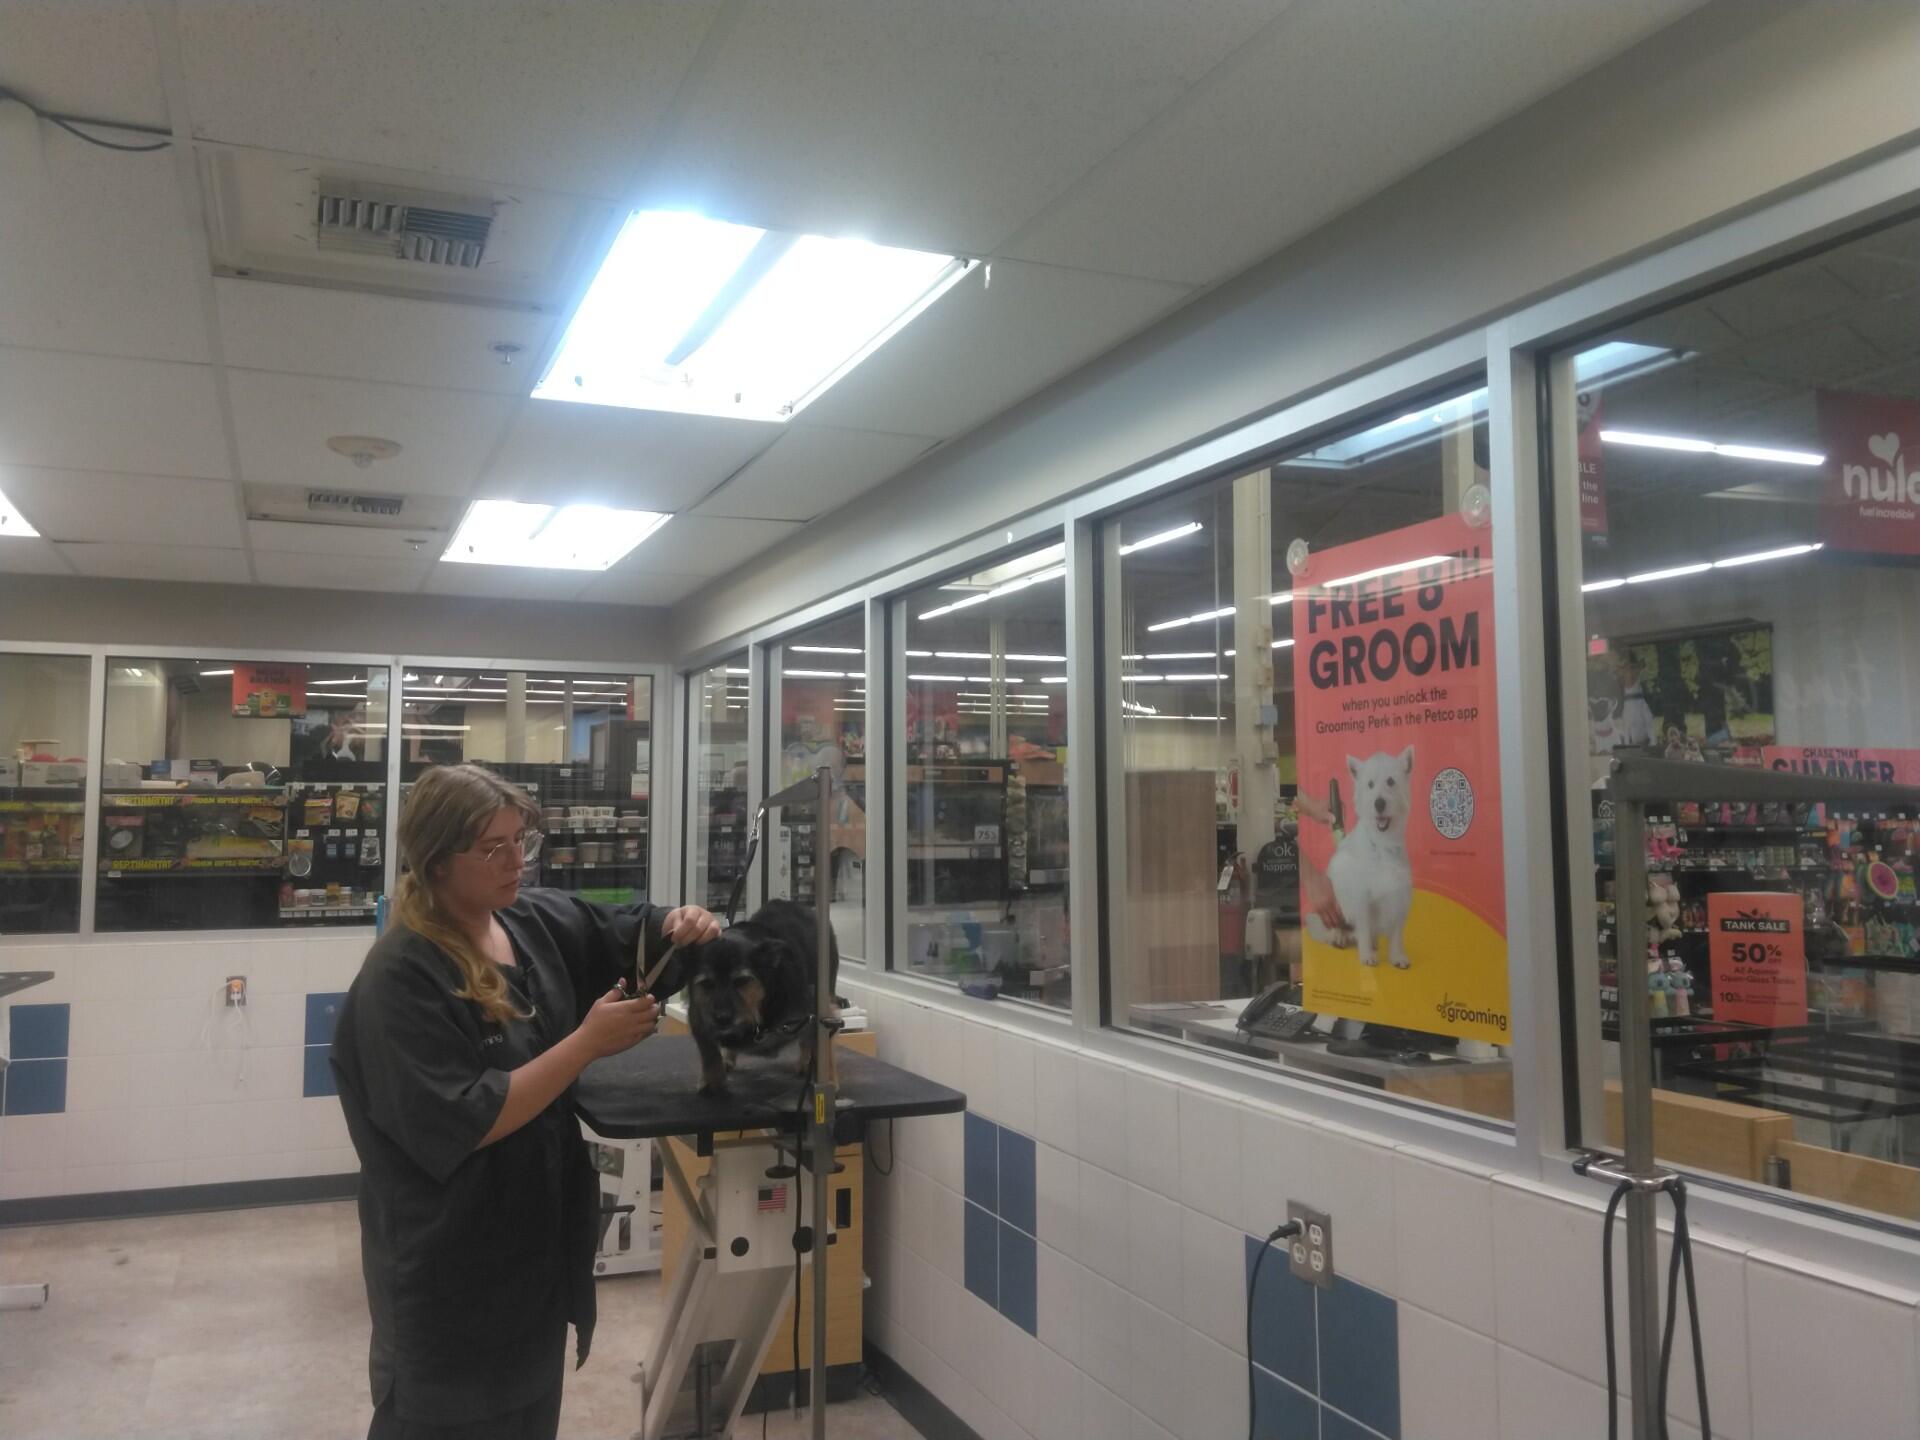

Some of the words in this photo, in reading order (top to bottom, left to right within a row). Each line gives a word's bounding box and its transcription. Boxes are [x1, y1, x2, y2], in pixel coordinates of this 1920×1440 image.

[1309, 569, 1405, 634] FREE
[1310, 612, 1480, 689] GROOM
[1342, 698, 1370, 712] when
[1371, 697, 1392, 713] you
[1393, 688, 1428, 706] unlock
[1430, 687, 1448, 702] the
[1316, 718, 1366, 734] Grooming
[1368, 714, 1390, 729] Perk
[1393, 713, 1403, 726] in
[1405, 712, 1422, 725] the
[1424, 708, 1455, 723] Petco
[1457, 707, 1478, 722] app
[1803, 748, 1833, 759] CHASE
[1836, 749, 1859, 759] THAT
[1726, 920, 1756, 931] TANK
[1758, 921, 1787, 932] SALE
[1732, 943, 1782, 963] 50%
[1447, 1007, 1507, 1031] grooming
